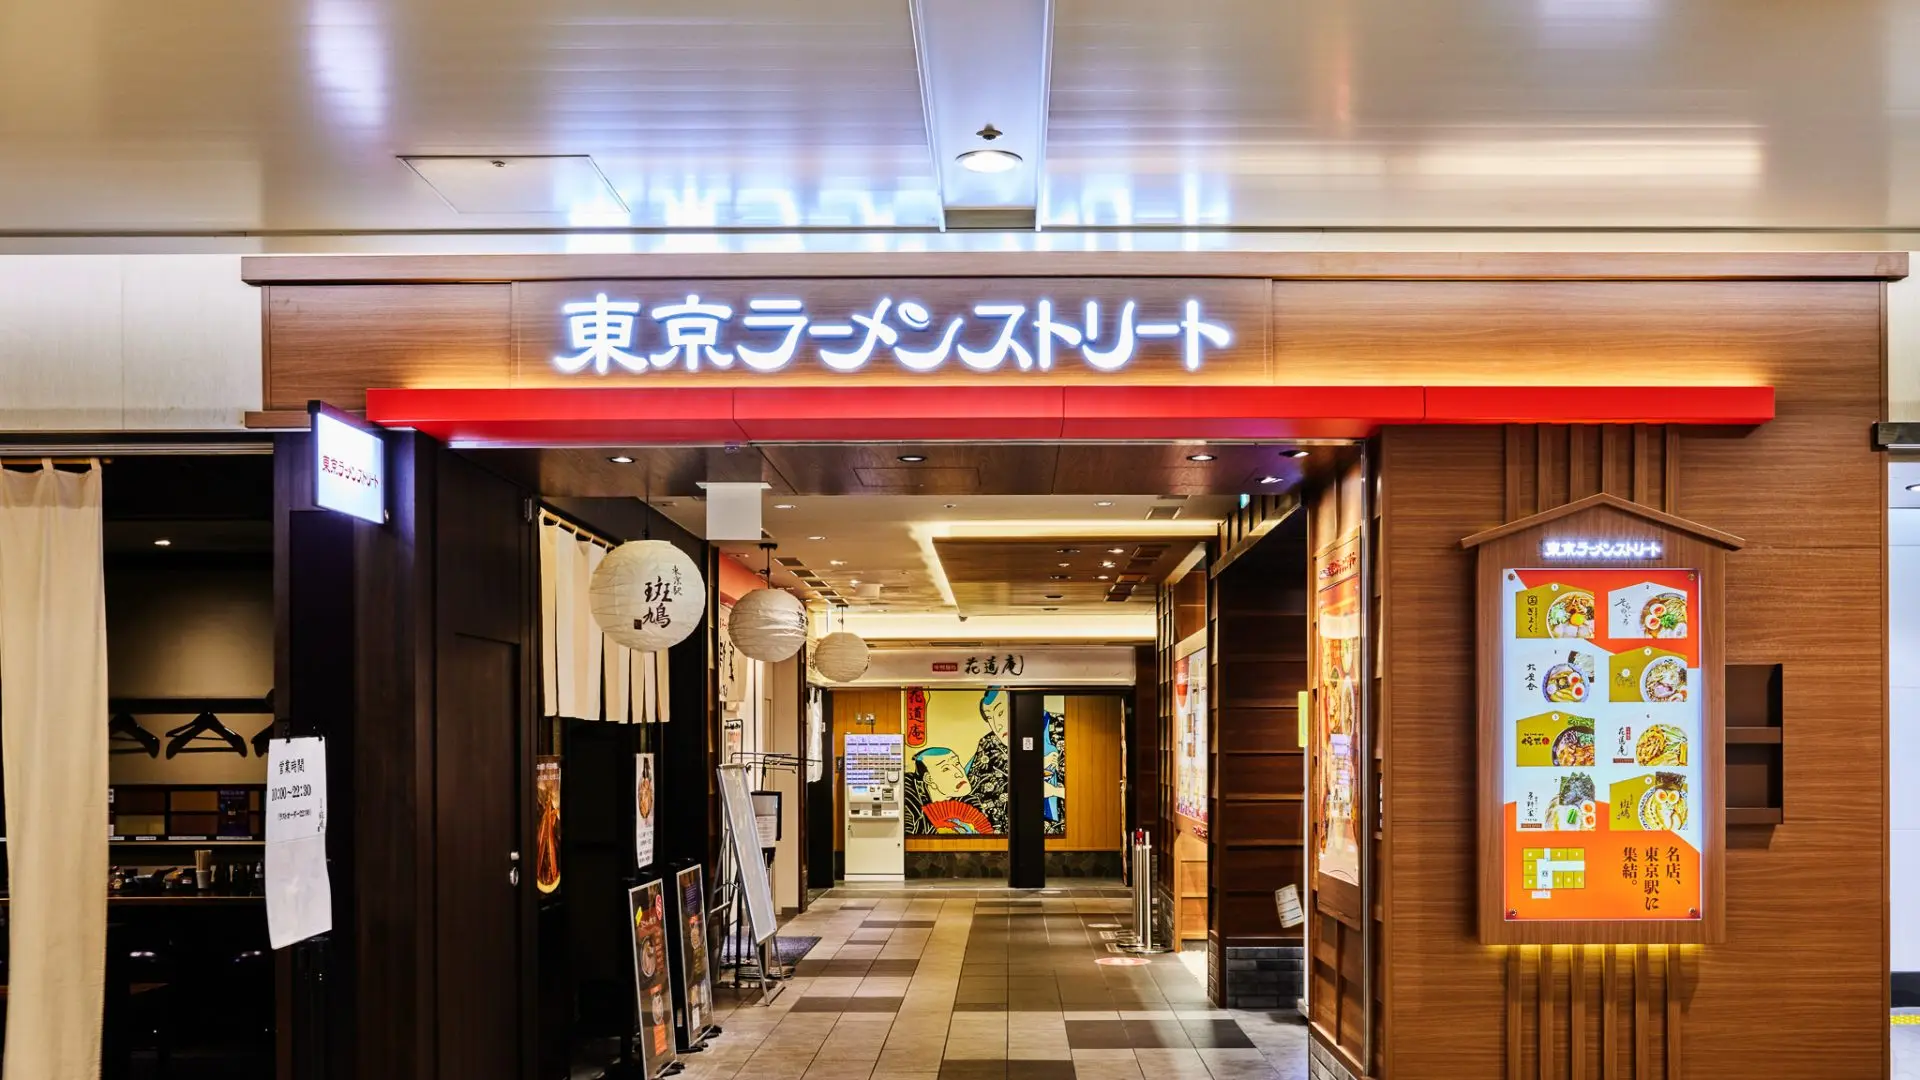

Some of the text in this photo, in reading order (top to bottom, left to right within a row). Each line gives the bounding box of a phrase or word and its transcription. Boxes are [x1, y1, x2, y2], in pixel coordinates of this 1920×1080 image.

[554, 292, 1231, 374] 東京ラーメンストリート
[965, 654, 1024, 676] 花道庵
[1622, 846, 1638, 886] 集結。
[1644, 846, 1659, 911] 東京駅に
[1666, 846, 1681, 885] 名店、
